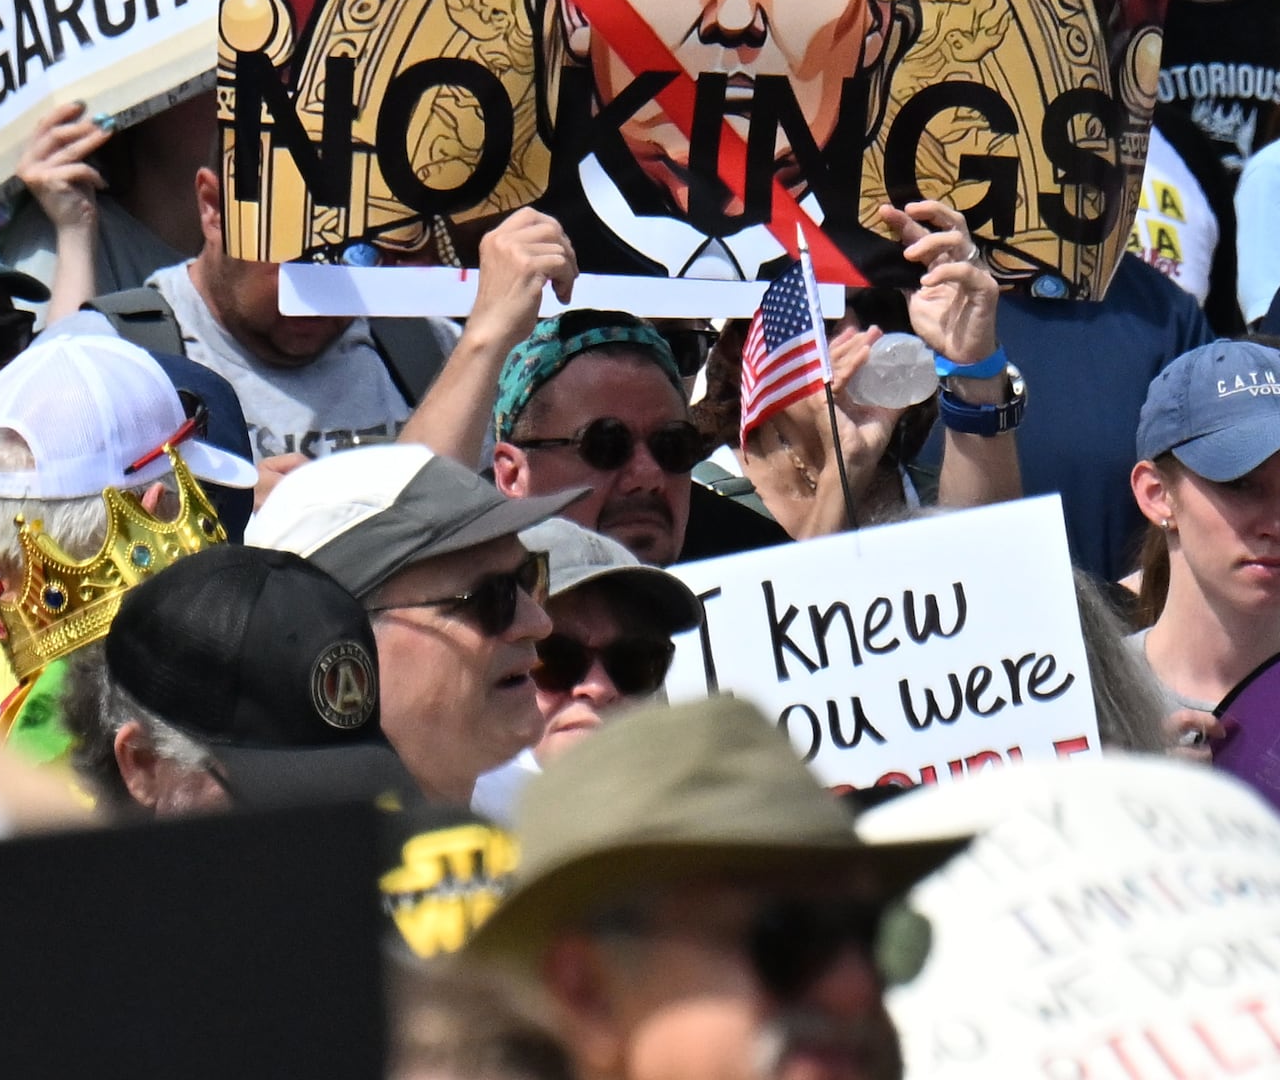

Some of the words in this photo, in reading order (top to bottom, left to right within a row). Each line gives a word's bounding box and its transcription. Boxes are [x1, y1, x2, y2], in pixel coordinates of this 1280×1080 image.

[228, 50, 516, 216] NO
[542, 67, 1124, 246] KINGS
[761, 579, 968, 683] knew
[776, 695, 887, 764] ou
[898, 652, 1075, 732] were
